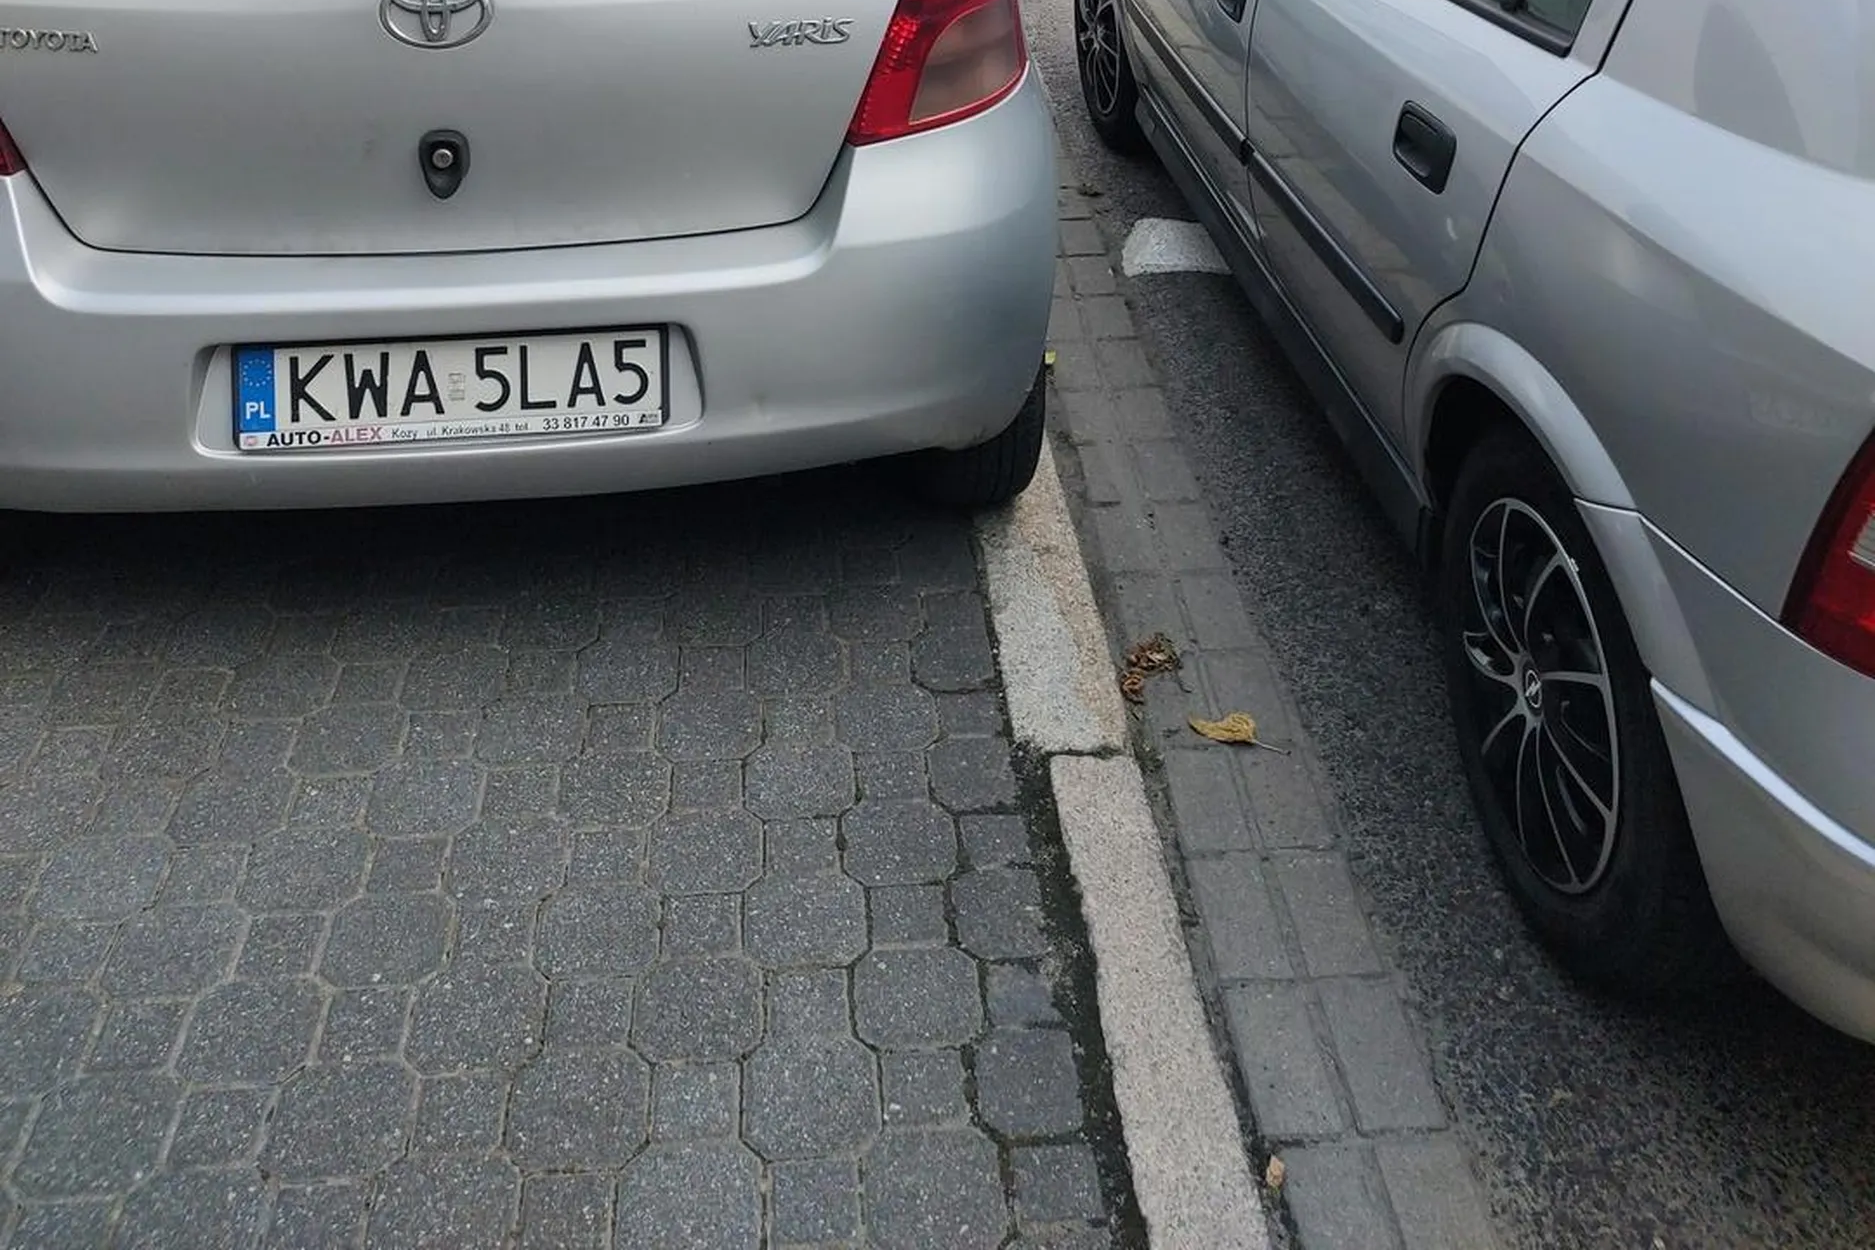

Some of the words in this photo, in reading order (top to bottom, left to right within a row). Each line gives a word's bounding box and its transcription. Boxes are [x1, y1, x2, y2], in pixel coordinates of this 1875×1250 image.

[0, 28, 98, 54] TOYOTA
[289, 350, 445, 423] KWA
[475, 339, 649, 412] 5LA5
[245, 402, 271, 419] PL
[266, 426, 382, 447] AUTO-ALEX
[392, 428, 418, 440] Kozy
[441, 424, 496, 436] Krakowska
[543, 417, 559, 431] 33
[563, 416, 588, 429] 817
[592, 415, 609, 428] 47
[612, 414, 630, 426] 90
